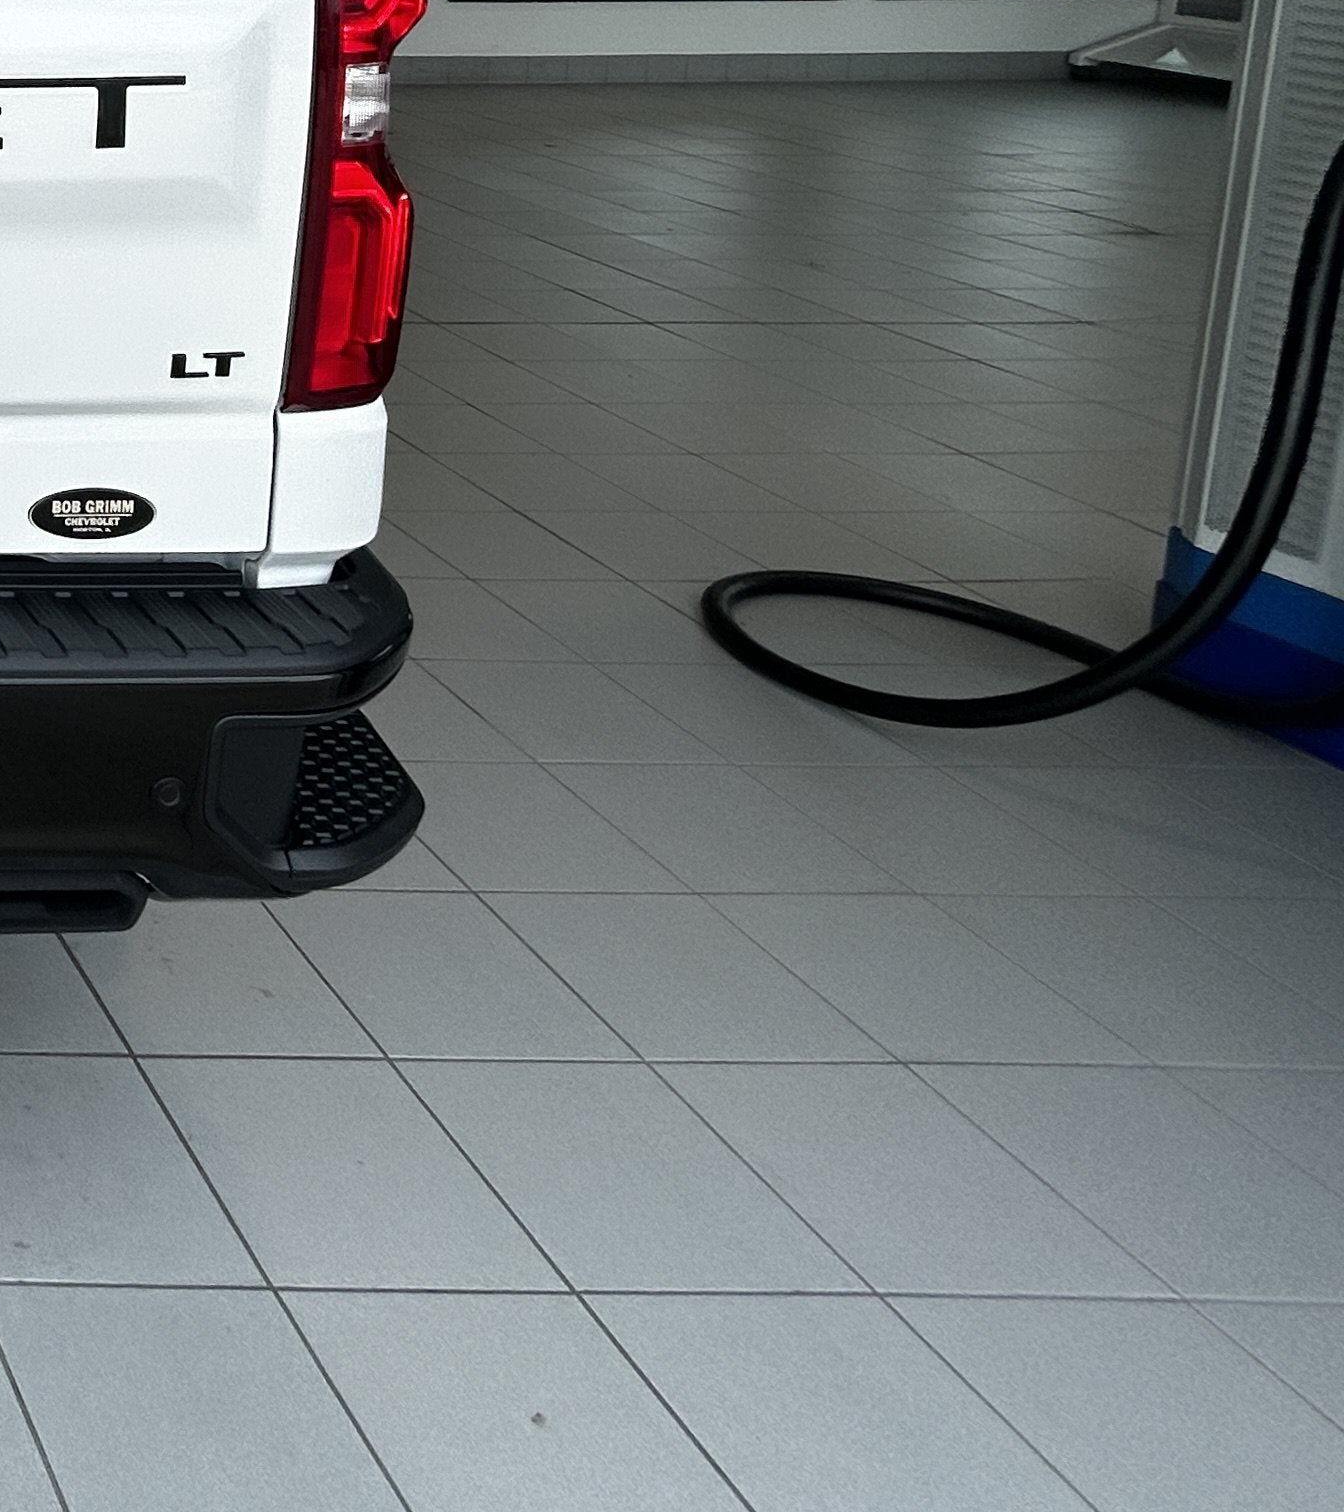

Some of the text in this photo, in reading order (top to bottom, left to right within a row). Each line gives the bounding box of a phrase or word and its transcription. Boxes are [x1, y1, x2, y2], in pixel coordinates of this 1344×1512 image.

[170, 351, 245, 379] LT
[52, 500, 135, 514] BOB GRIMM
[64, 517, 120, 527] CHEVROLET
